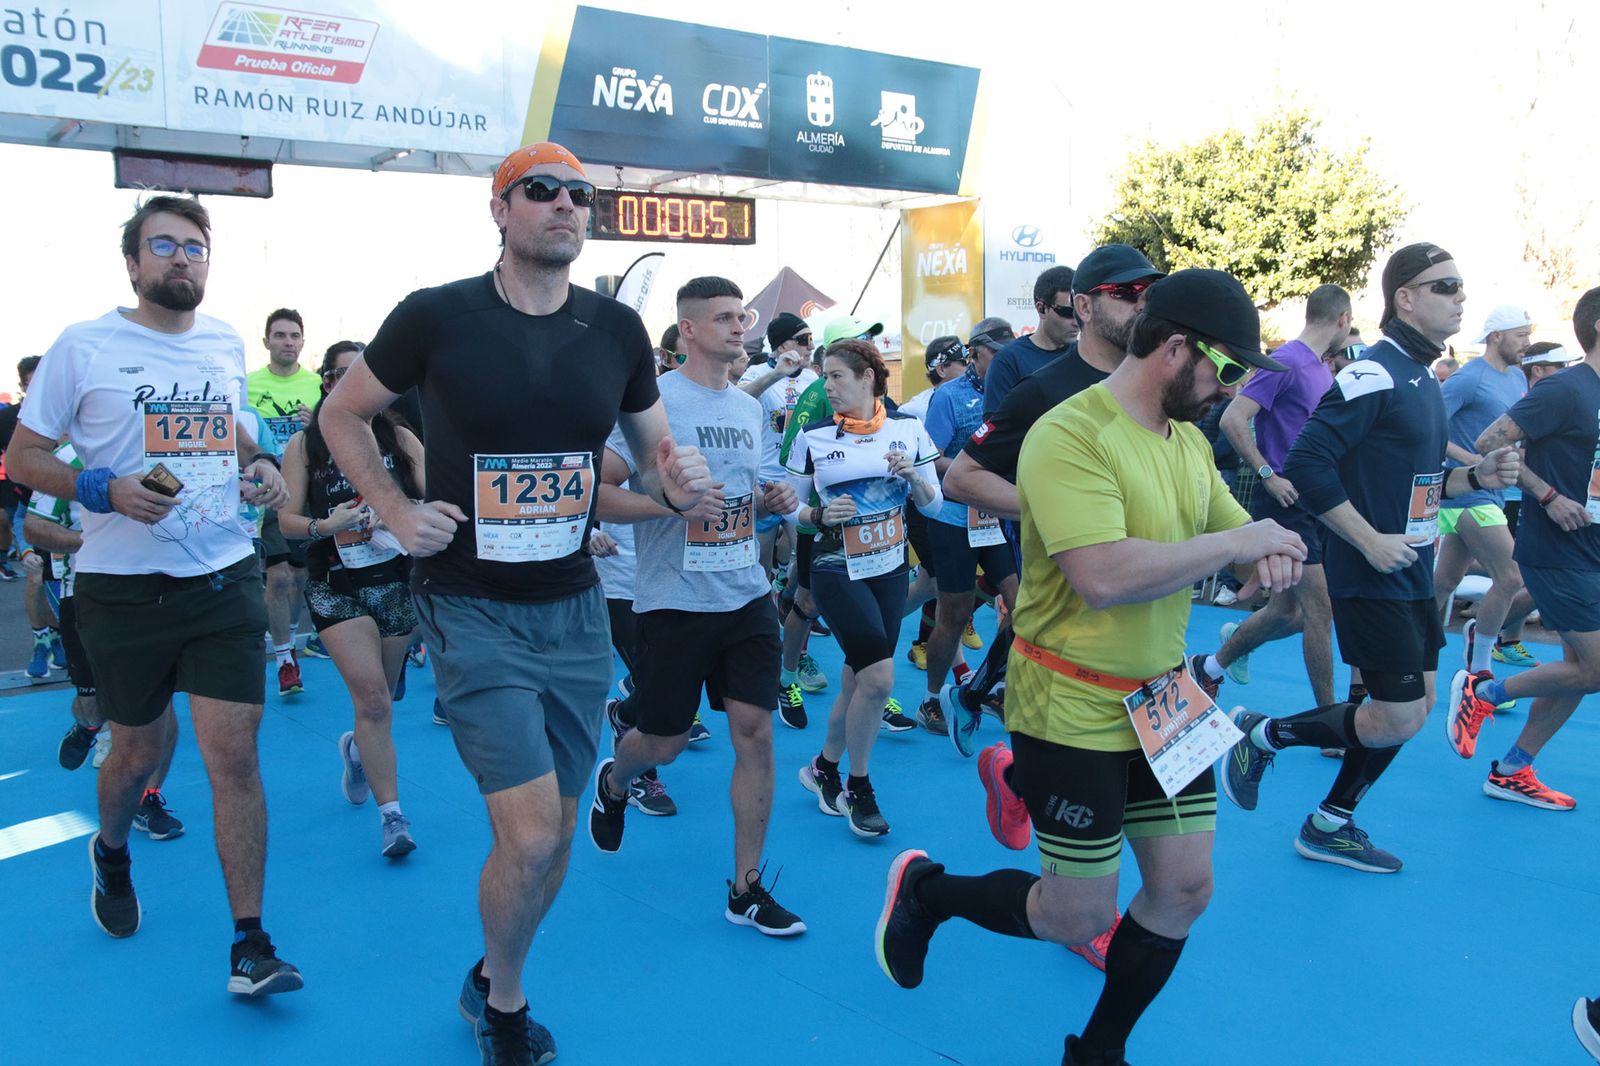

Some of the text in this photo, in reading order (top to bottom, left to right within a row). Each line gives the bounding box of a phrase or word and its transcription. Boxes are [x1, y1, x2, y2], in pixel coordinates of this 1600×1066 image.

[4, 7, 107, 46] atón
[284, 16, 342, 33] RFEA
[273, 39, 334, 55] RUNNING
[279, 29, 366, 49] ATLETISMO
[234, 54, 337, 77] Prueba Oficial
[612, 66, 637, 78] GRUPO
[592, 74, 674, 116] NEXA
[702, 82, 767, 120] CDX
[193, 86, 488, 132] RAMÓN RUIZ ANDÚJAR
[796, 131, 845, 147] ALMERÍA
[808, 143, 834, 154] CIUDAD
[917, 243, 968, 277] NEXA
[1000, 250, 1056, 263] HYUNDAI
[156, 415, 229, 441] 1278
[696, 426, 754, 450] HWPO
[491, 471, 584, 504] 1234
[858, 518, 896, 545] 616
[1145, 680, 1190, 732] 512
